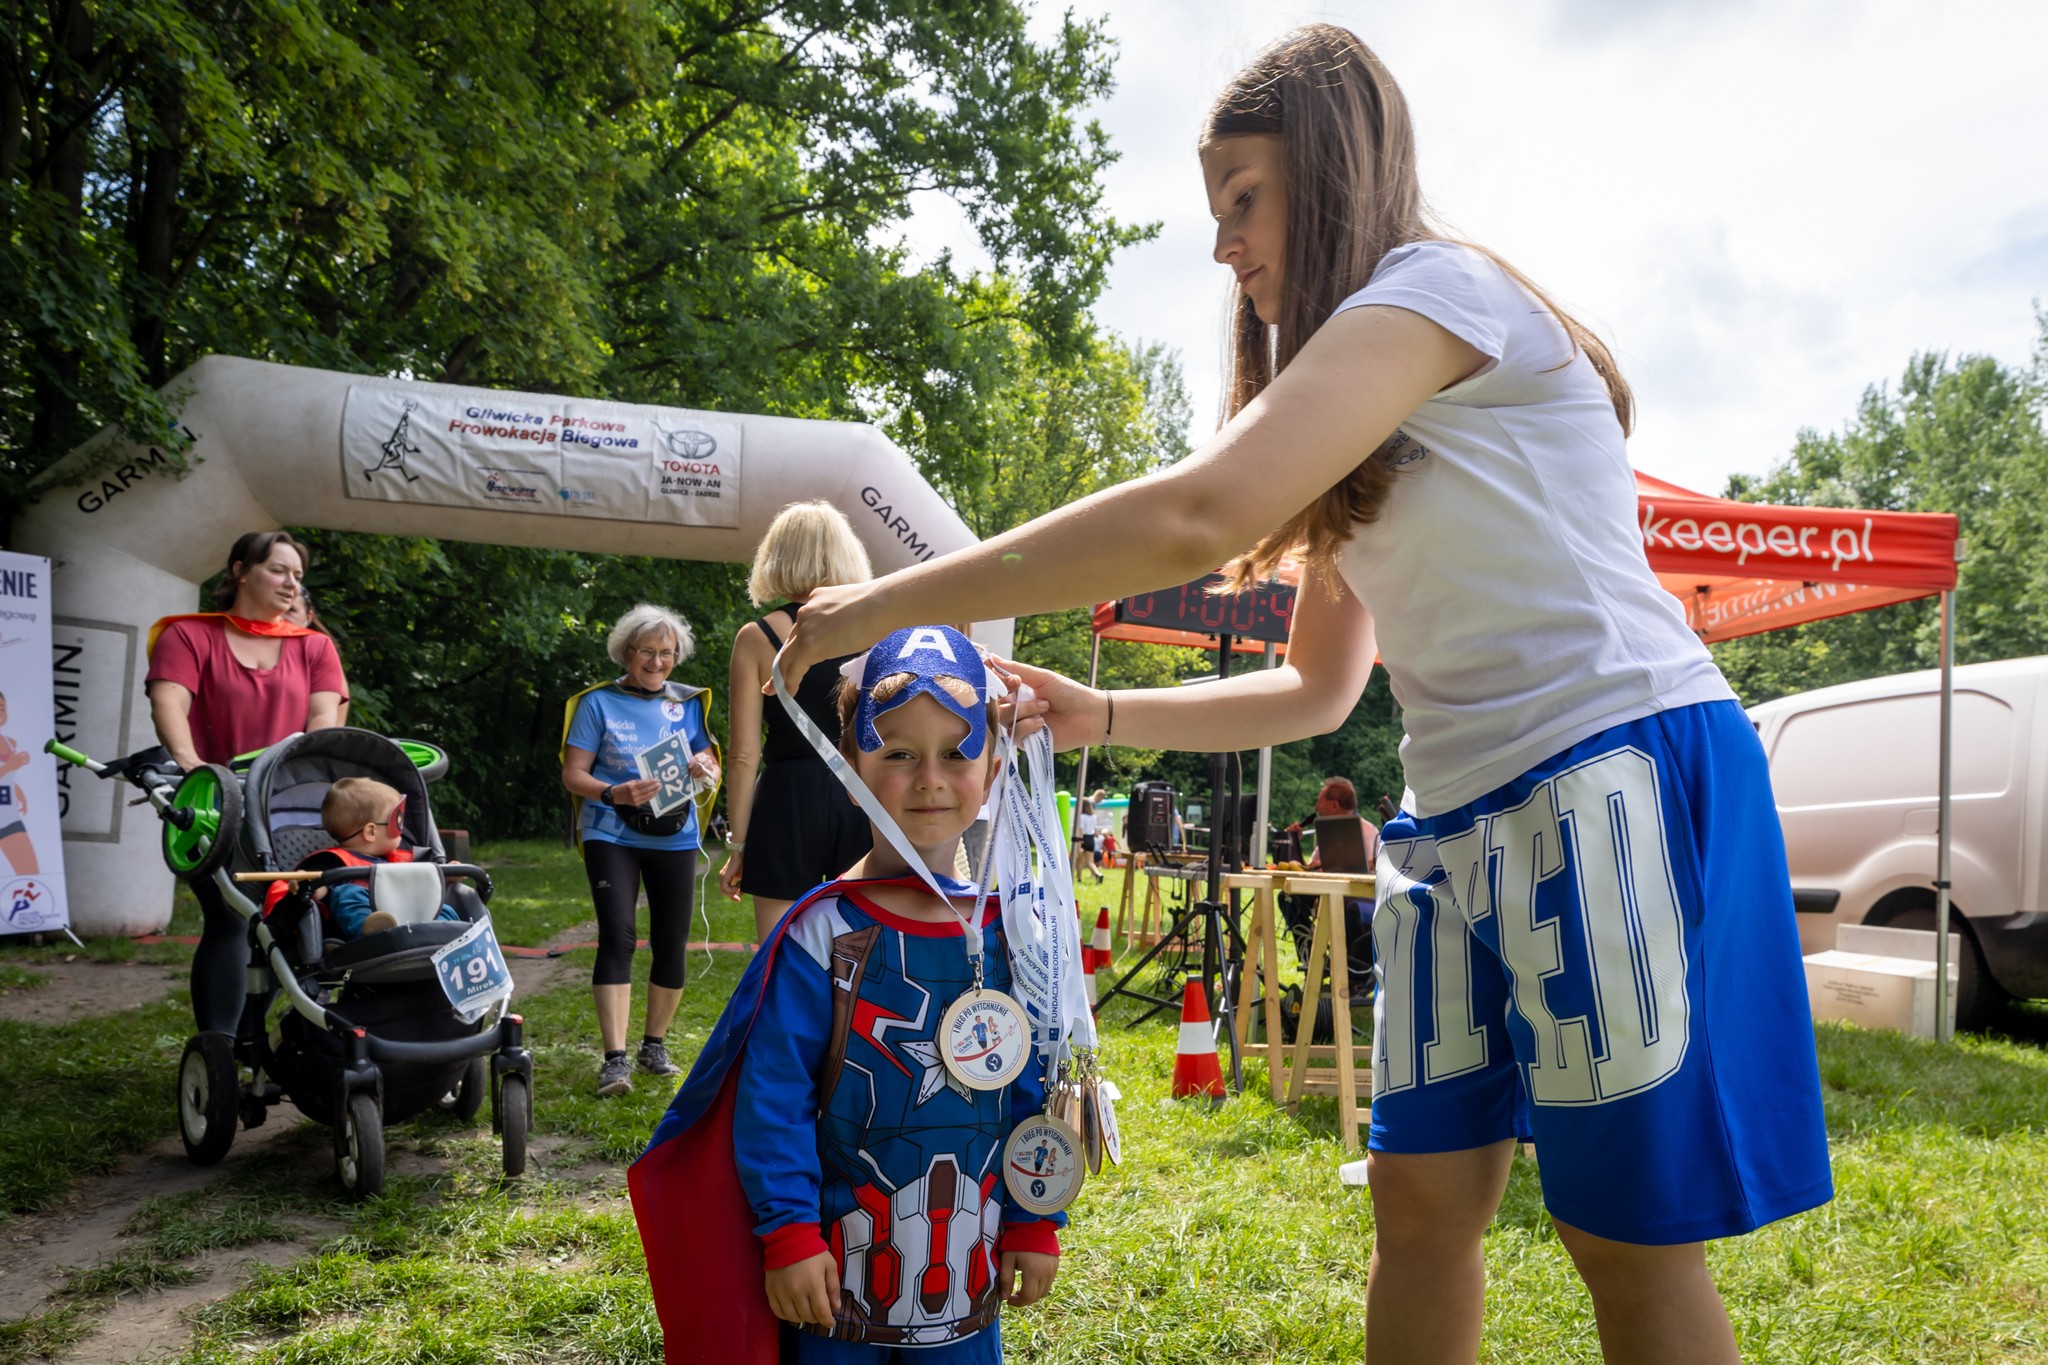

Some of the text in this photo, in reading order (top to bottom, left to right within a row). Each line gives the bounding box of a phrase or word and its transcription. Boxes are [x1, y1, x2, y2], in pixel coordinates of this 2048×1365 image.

[448, 418, 639, 448] Prowokacja Biegowa
[466, 406, 626, 432] Gliwicka Parkowa
[661, 460, 721, 475] TOYOTA
[861, 486, 935, 562] GARMI
[0, 569, 38, 599] NIE
[897, 628, 958, 664] A
[656, 751, 684, 798] 192
[1013, 777, 1032, 814] FUNDACJA
[1027, 810, 1057, 870] NIEODKŁADALNI
[449, 947, 499, 991] 191
[1013, 963, 1037, 999] FUNDACJA
[1051, 915, 1060, 1024] FUNDACJA NIEODKŁADALNI
[466, 979, 495, 995] Mirek
[954, 1015, 967, 1031] BIEG
[963, 1008, 973, 1019] PO
[971, 1002, 1009, 1018] WYTCHNIENIE
[1020, 1128, 1072, 1157] I BIEG PO WYTCHNIENIE
